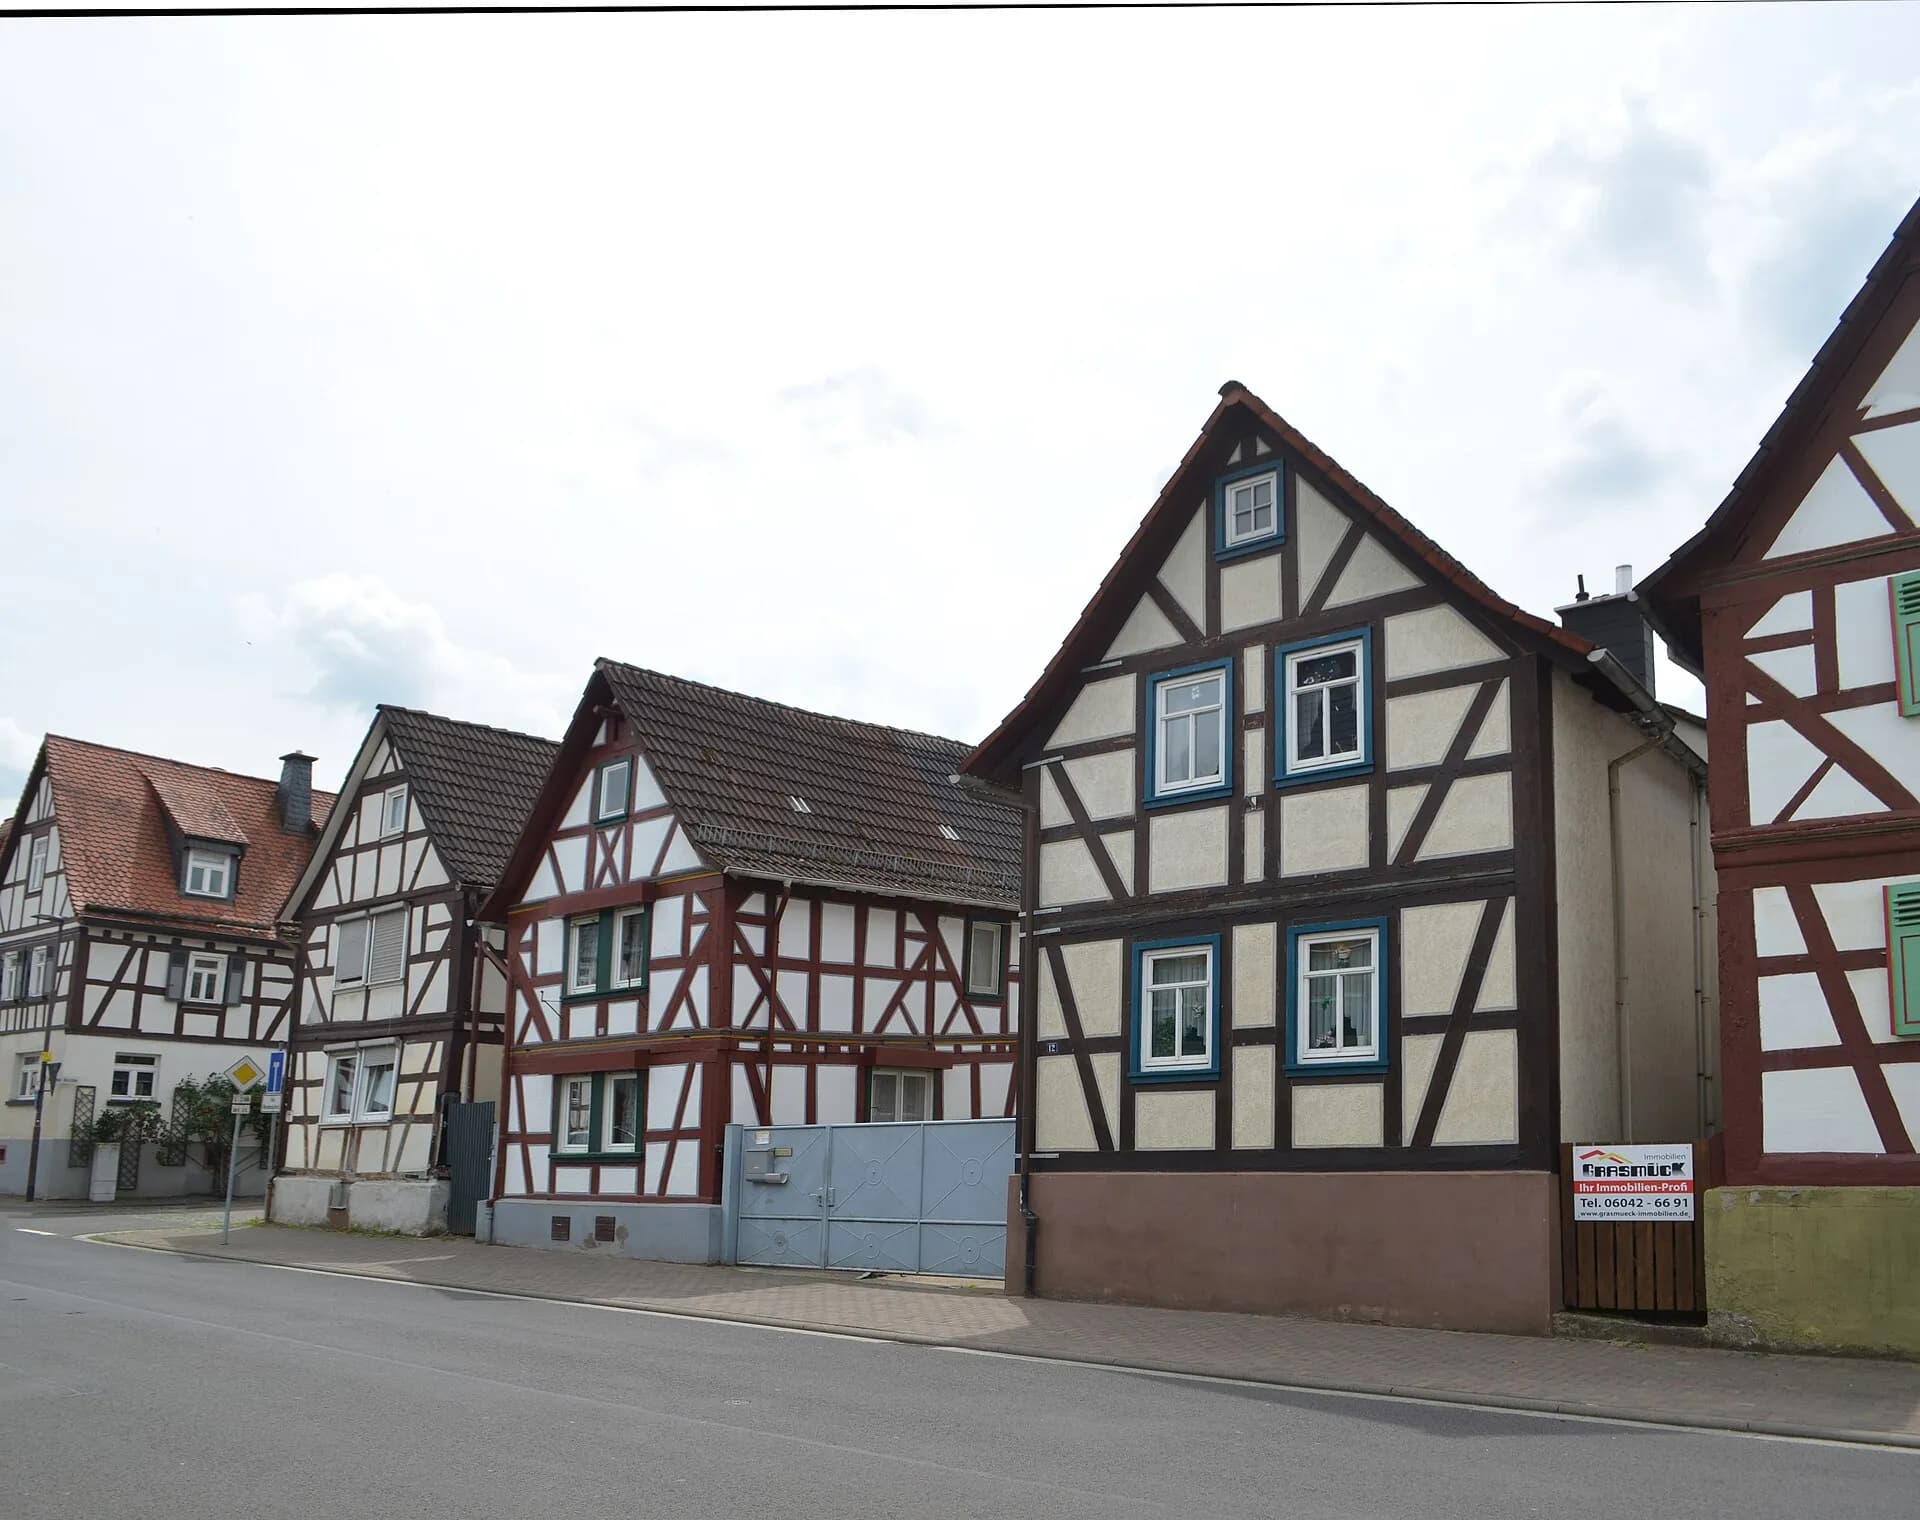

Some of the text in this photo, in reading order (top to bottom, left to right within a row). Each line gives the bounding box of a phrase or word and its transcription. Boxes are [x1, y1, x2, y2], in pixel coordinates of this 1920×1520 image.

[1644, 1152, 1686, 1160] Immobilien
[1579, 1182, 1688, 1192] Ihr Immobilien-Profi
[1580, 1198, 1601, 1208] Tel.
[1604, 1198, 1644, 1208] 06042
[1654, 1198, 1671, 1208] 66
[1673, 1198, 1688, 1208] 91
[1580, 1210, 1689, 1218] www.grasmueck-immobilien.de
